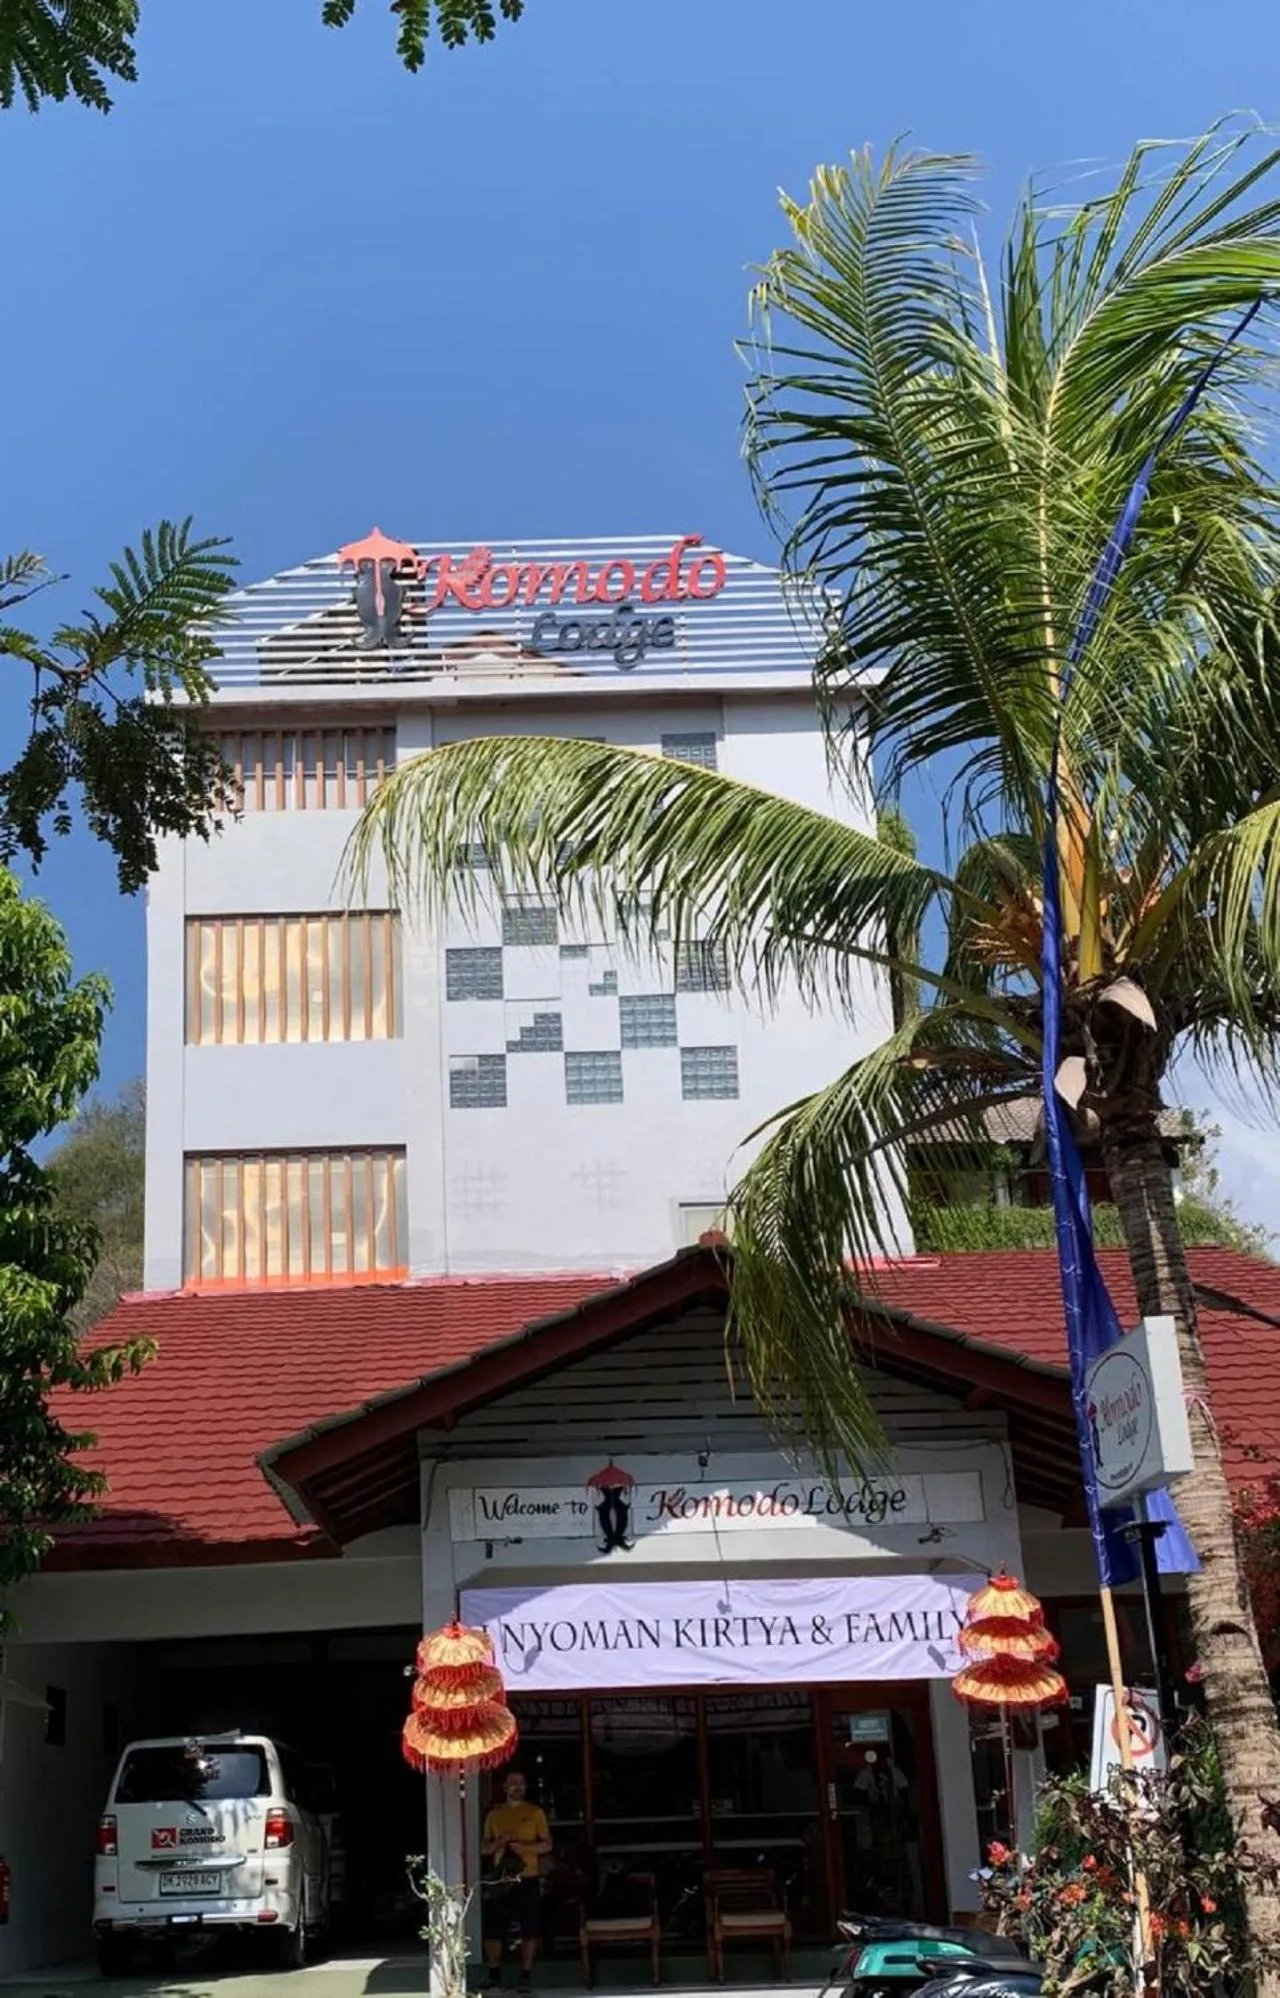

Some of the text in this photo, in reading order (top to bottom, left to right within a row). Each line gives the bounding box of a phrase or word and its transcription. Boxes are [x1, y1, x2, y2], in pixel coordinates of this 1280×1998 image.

[405, 533, 727, 614] Komodo
[520, 604, 677, 671] Lodge
[478, 1479, 907, 1524] Welcome to Komodo Lodge
[501, 1610, 969, 1653] NYOMAN KIRTYA & FAMILY
